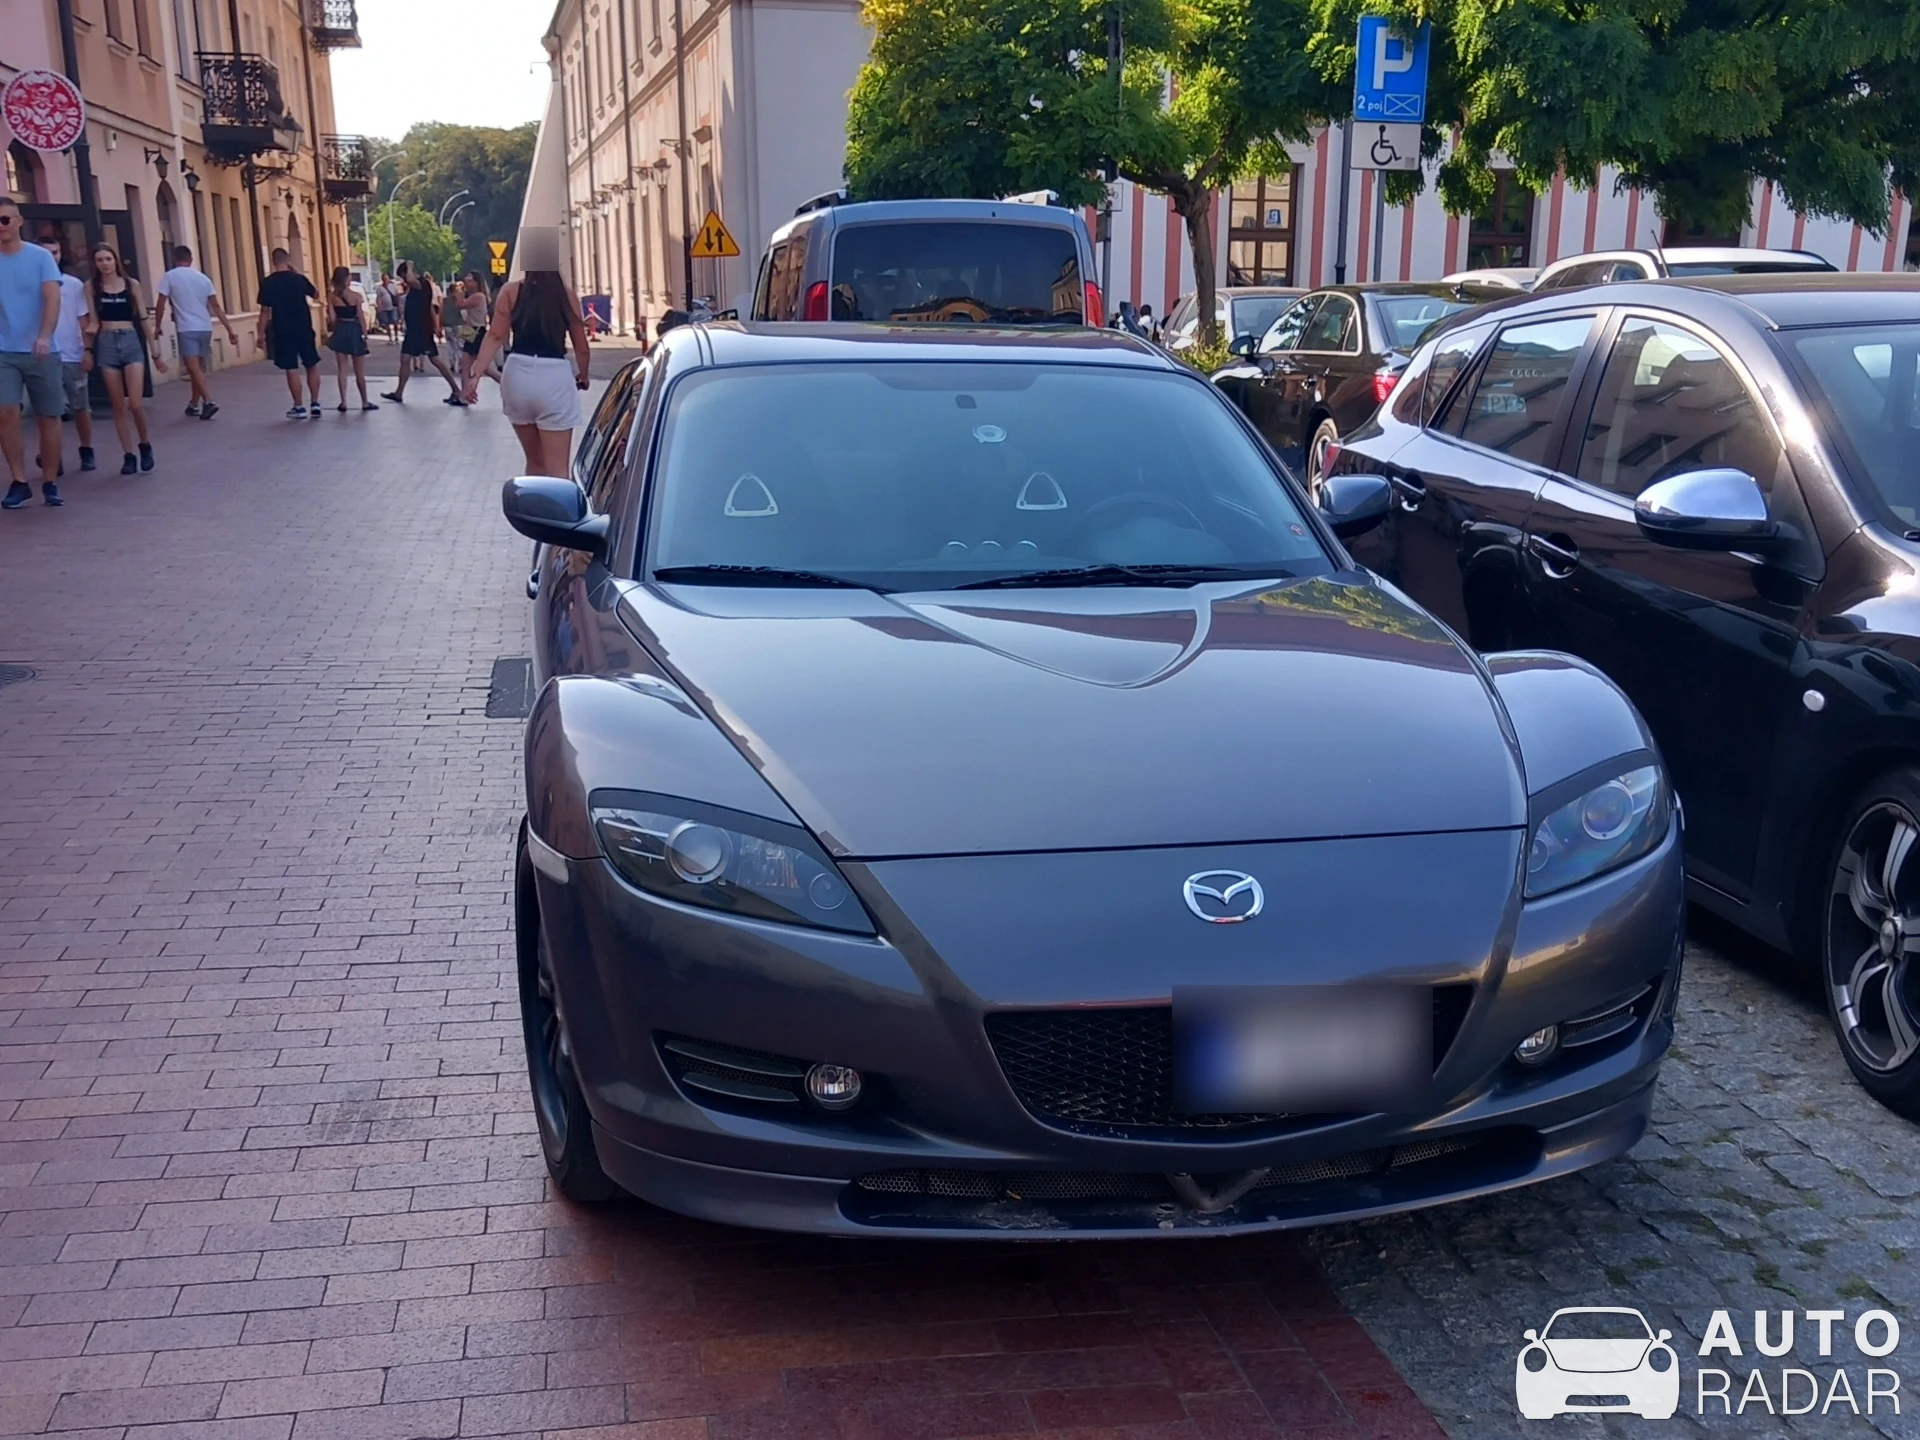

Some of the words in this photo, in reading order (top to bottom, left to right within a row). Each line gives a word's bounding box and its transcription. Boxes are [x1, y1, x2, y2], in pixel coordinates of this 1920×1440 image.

[1373, 26, 1413, 89] P
[1357, 94, 1366, 109] 2
[7, 105, 48, 147] POWER
[50, 106, 79, 147] KEBAB
